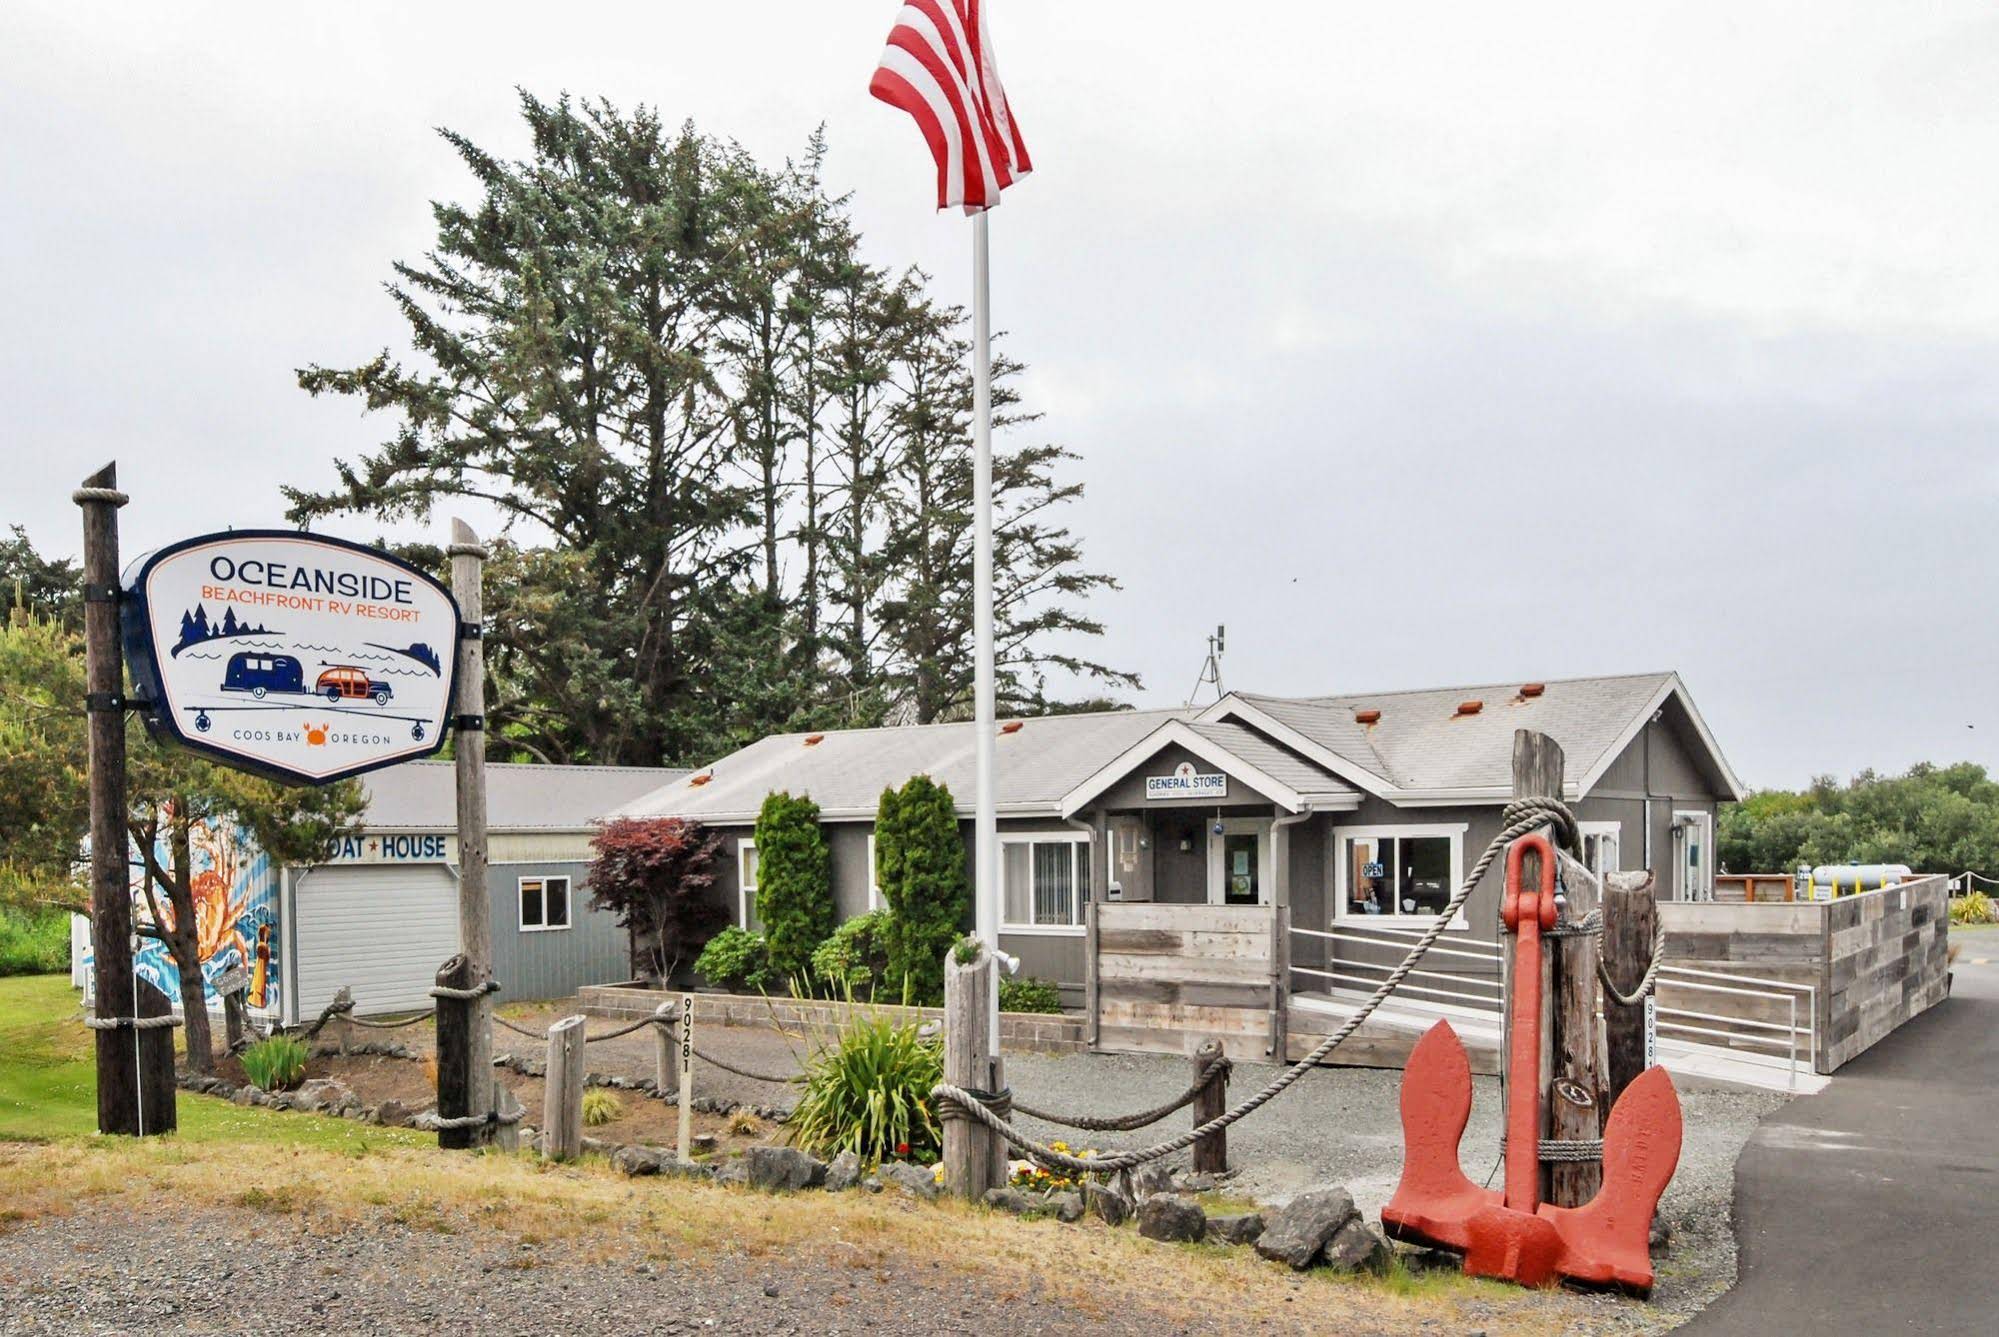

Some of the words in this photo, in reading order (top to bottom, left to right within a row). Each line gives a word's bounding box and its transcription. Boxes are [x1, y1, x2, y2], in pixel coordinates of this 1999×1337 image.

[210, 556, 413, 604] OCEANSIDE
[201, 585, 323, 612] BEACHFRONT
[328, 600, 352, 616] RV
[356, 604, 421, 623] RESORT
[233, 729, 272, 741] COOS
[277, 731, 301, 742] BAY
[331, 733, 391, 744] OREGON
[1149, 778, 1190, 789] GENERAL
[1193, 776, 1224, 788] STORE
[327, 835, 366, 858] OAT
[382, 836, 446, 858] HOUSE
[1363, 865, 1382, 876] OPEN
[682, 998, 692, 1073] 90281
